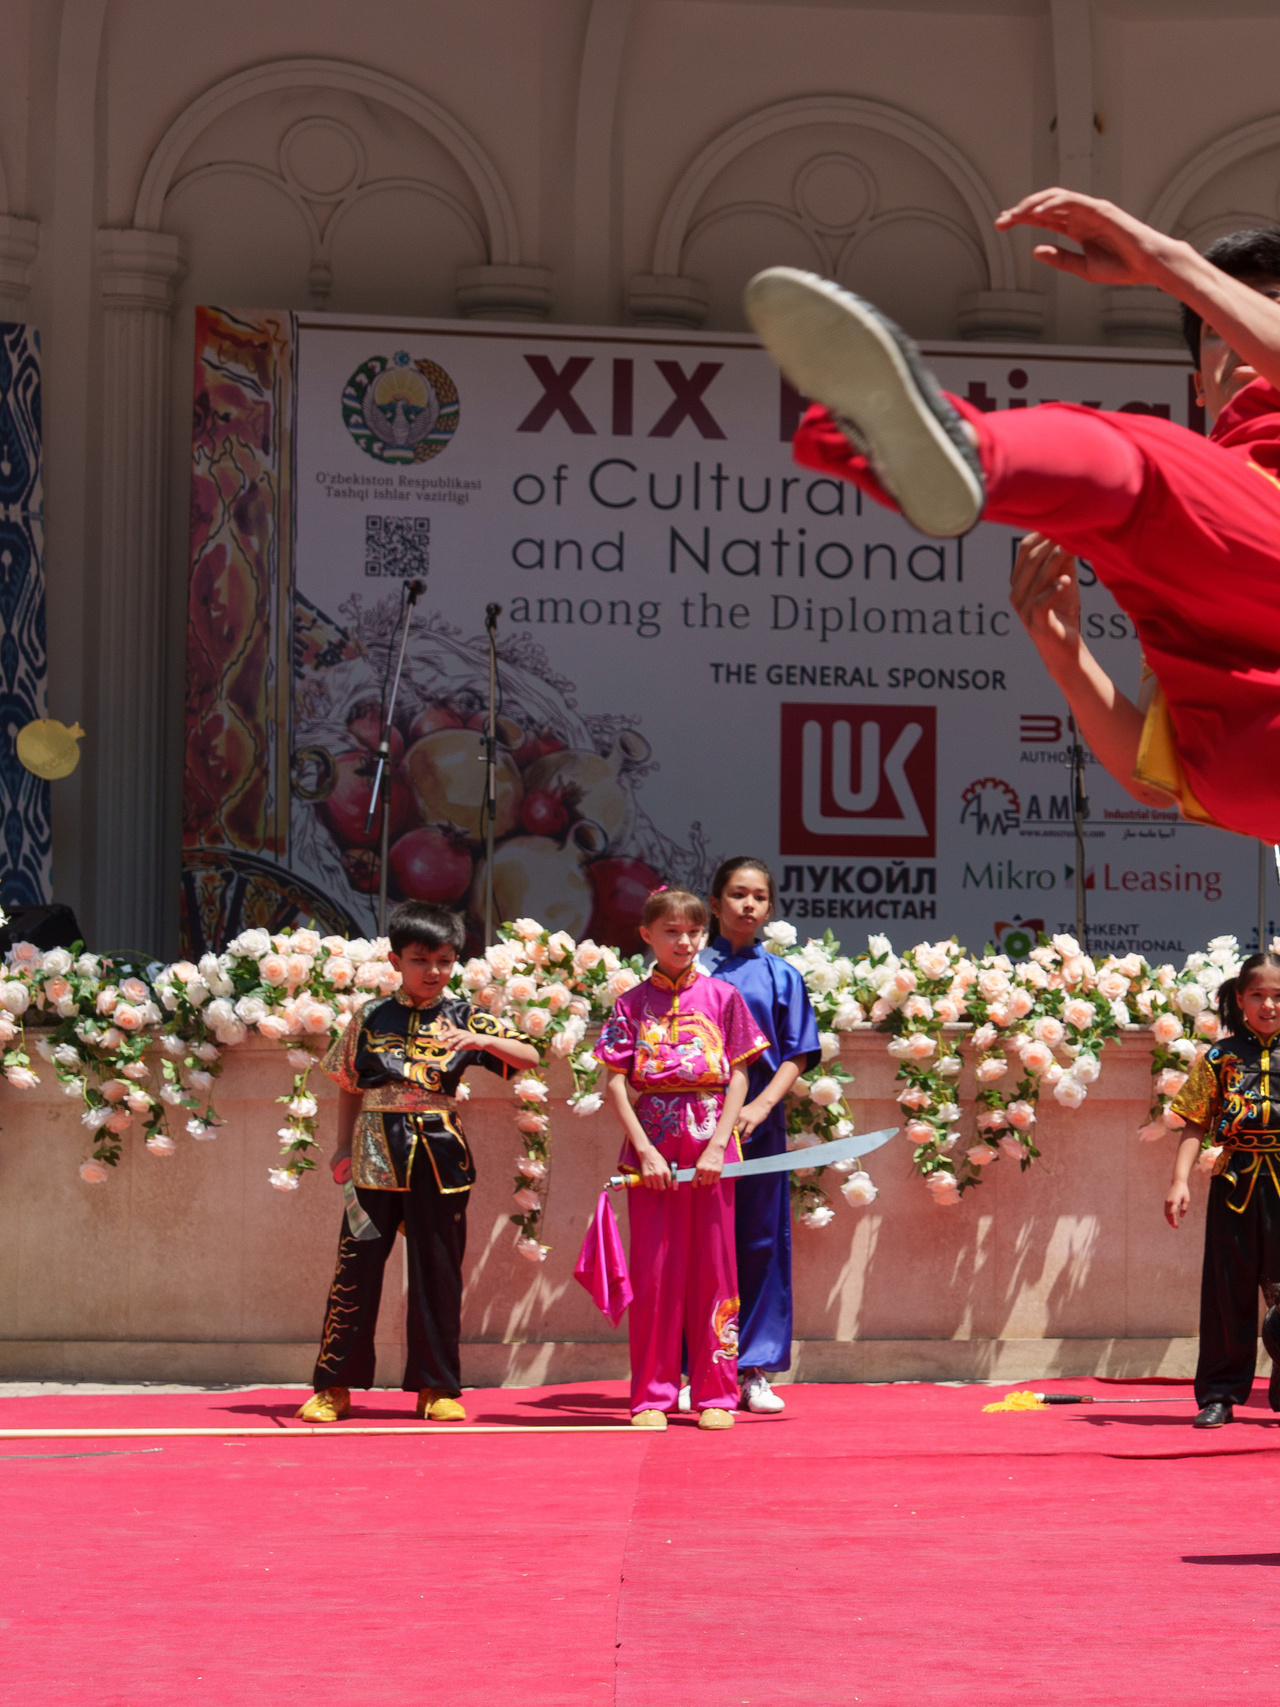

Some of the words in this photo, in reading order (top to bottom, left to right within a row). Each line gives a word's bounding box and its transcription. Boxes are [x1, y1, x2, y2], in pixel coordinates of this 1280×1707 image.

[516, 354, 728, 440] XIX
[325, 485, 369, 502] Tashqi
[373, 487, 412, 500] ishlar
[416, 490, 469, 506] vazirligi
[398, 475, 481, 492] Respublikasi
[513, 464, 569, 505] of
[511, 531, 625, 573] and
[669, 526, 965, 583] National
[510, 596, 662, 638] among
[681, 592, 751, 630] the
[770, 593, 1010, 643] Diplomatic
[710, 663, 757, 684] THE
[766, 664, 879, 688] GENERAL
[887, 668, 1007, 690] SPONSOR
[1104, 808, 1150, 820] Industrial
[1151, 810, 1179, 823] Group
[779, 861, 937, 894] ЛУКОЙЛ
[961, 860, 1057, 890] Mikro
[1104, 864, 1222, 901] Leasing
[779, 898, 937, 919] УЗБЕКИСТАН
[1058, 923, 1140, 936] TAHKENT
